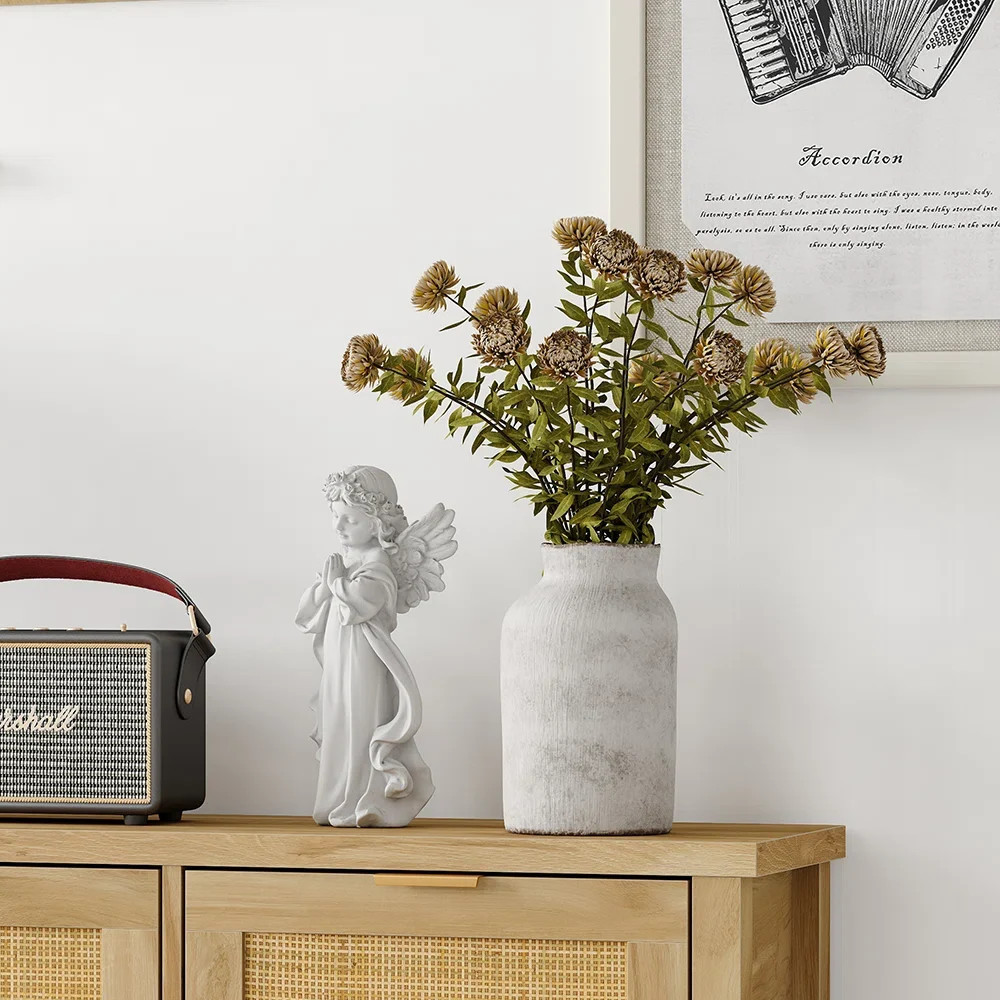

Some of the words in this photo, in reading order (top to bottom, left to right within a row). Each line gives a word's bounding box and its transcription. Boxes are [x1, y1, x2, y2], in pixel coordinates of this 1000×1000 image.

[799, 145, 903, 167] Accordion
[728, 192, 740, 201] it's
[743, 193, 754, 201] all
[839, 191, 852, 199] but
[854, 190, 868, 198] also
[871, 190, 888, 198] with
[700, 211, 732, 219] listening
[743, 209, 754, 217] the
[795, 208, 809, 216] also
[811, 207, 828, 216] with
[829, 207, 840, 215] the
[842, 207, 862, 215] heart
[779, 224, 800, 233] Since
[823, 225, 839, 234] only
[841, 225, 850, 234] by
[852, 225, 879, 233] singing
[967, 221, 979, 229] the
[838, 241, 854, 250] only
